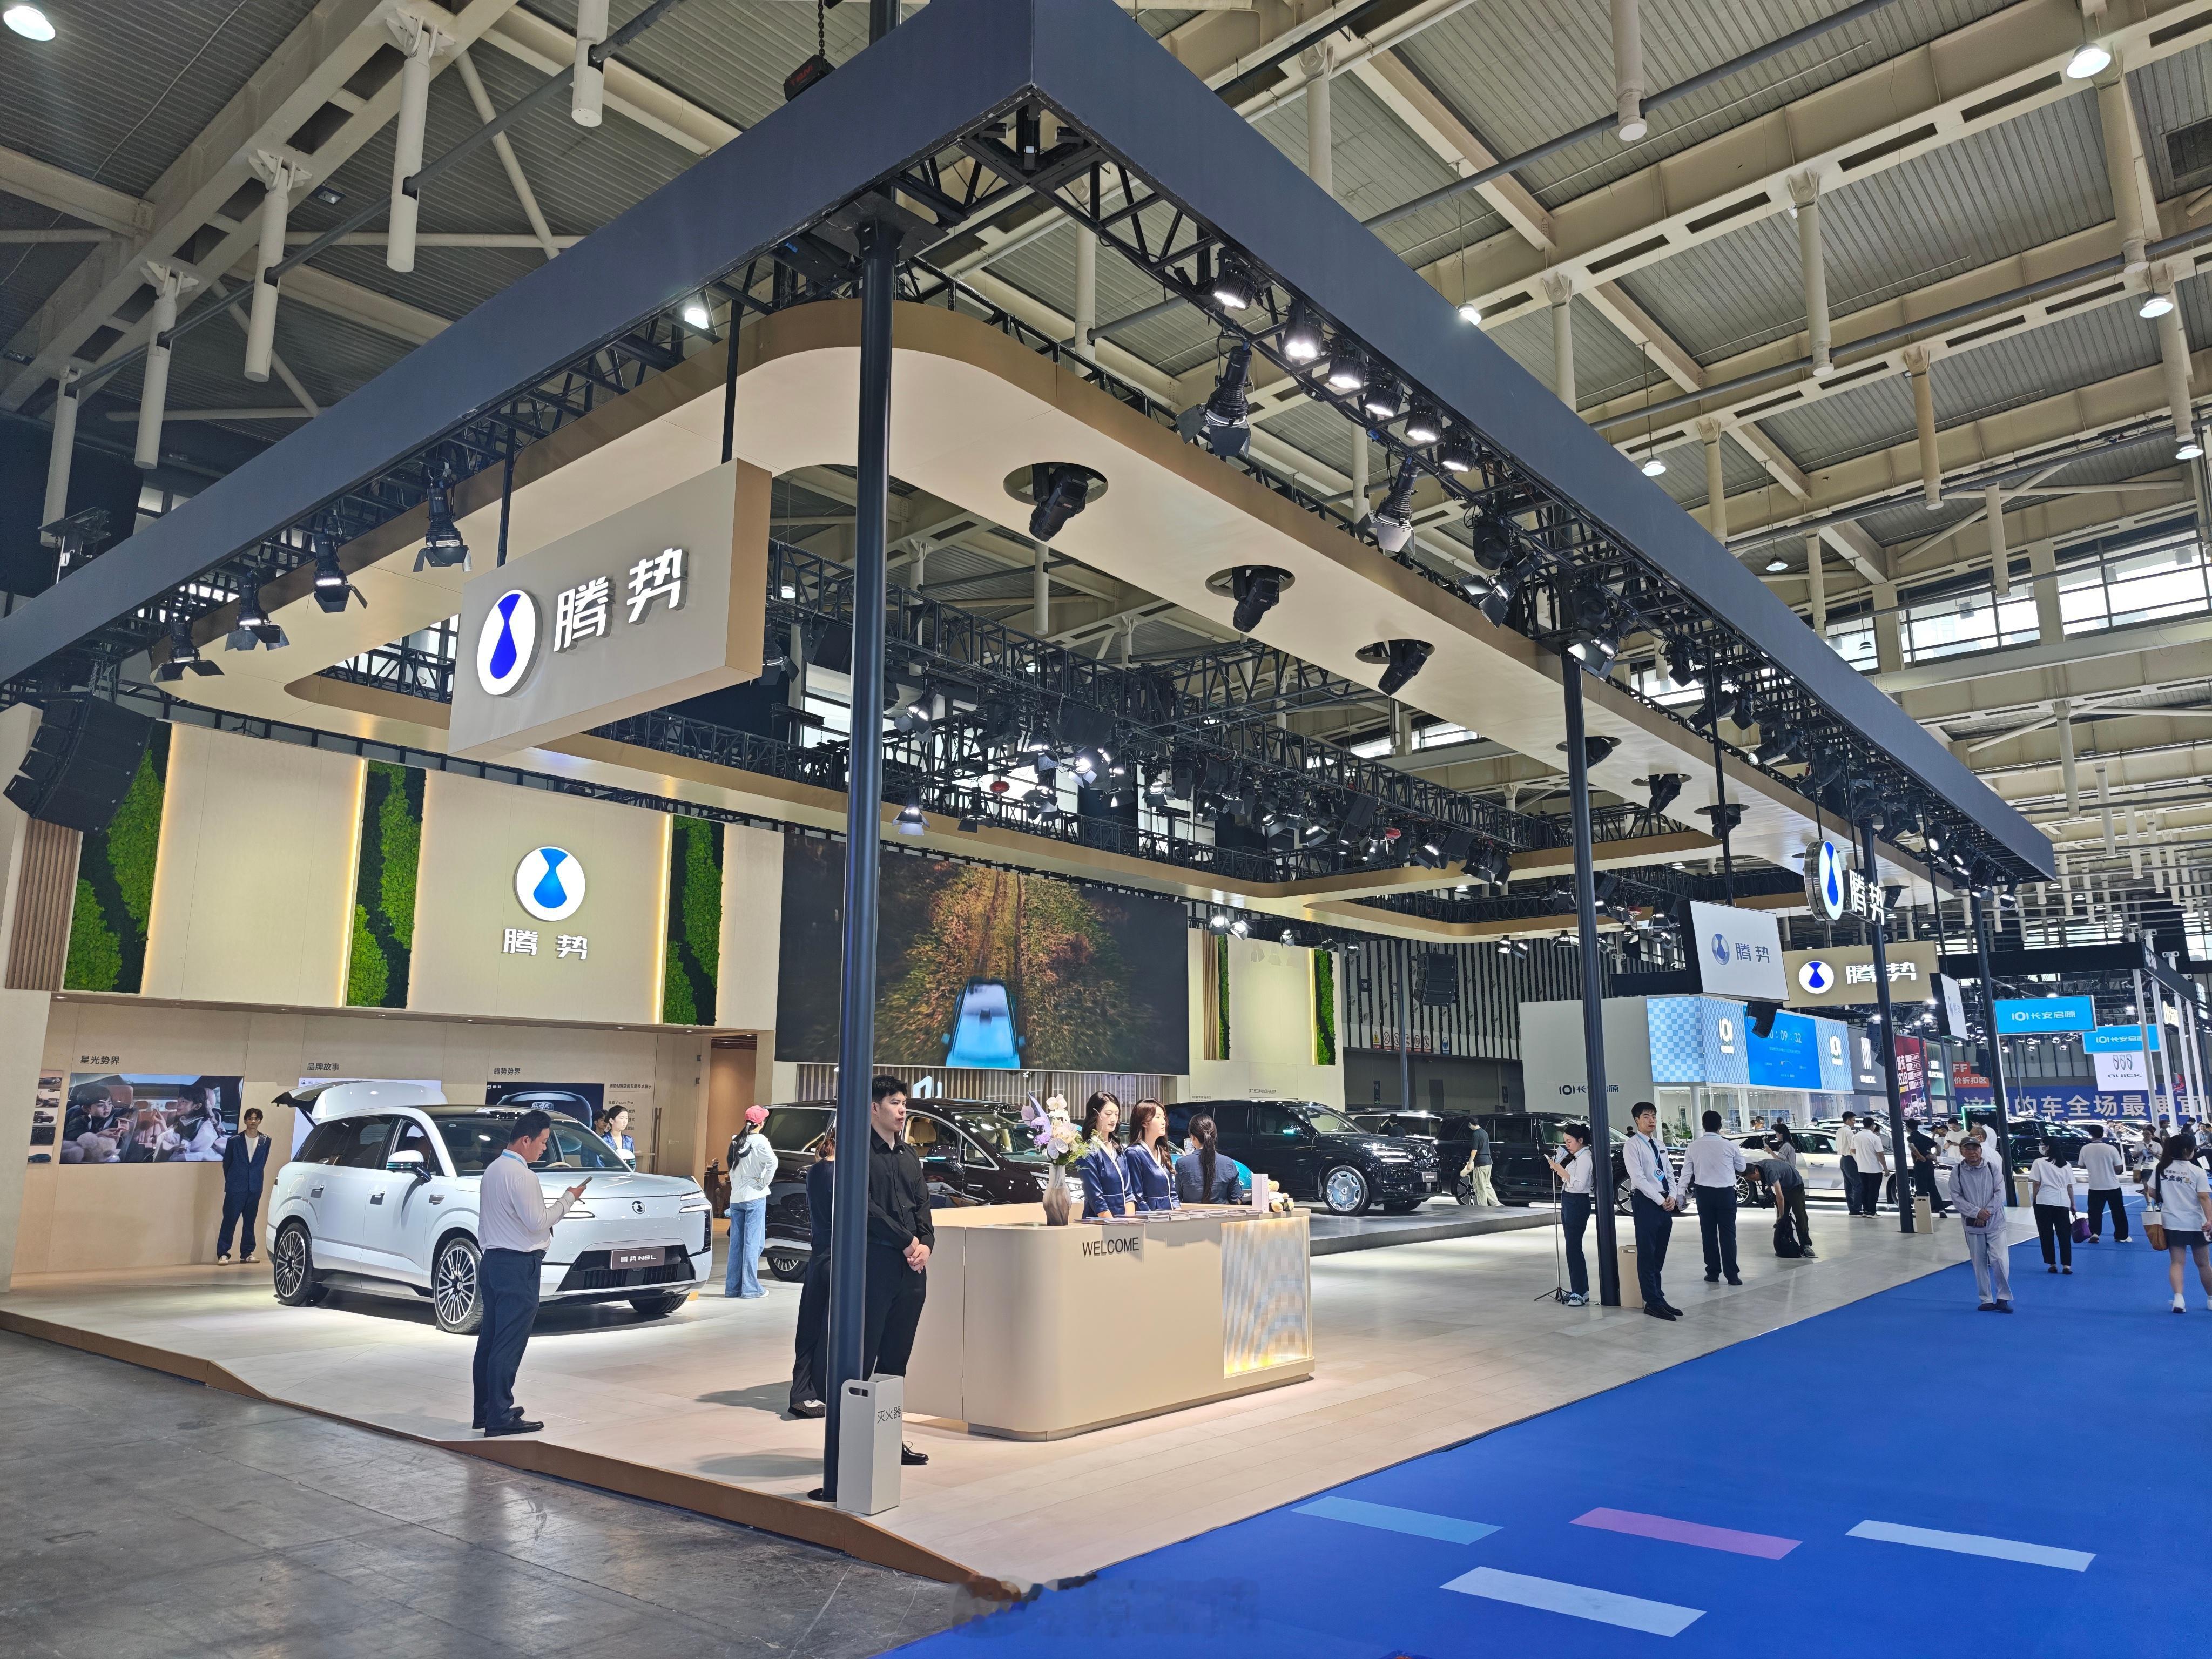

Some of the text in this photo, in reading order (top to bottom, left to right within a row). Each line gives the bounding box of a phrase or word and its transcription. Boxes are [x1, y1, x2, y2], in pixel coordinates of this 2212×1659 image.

[554, 547, 687, 652] 腾势
[1849, 869, 1885, 926] 腾势
[502, 928, 588, 960] 腾势
[1735, 942, 1770, 963] 腾势
[1845, 962, 1917, 984] 腾势
[80, 1055, 120, 1065] 星光势界
[307, 1062, 340, 1071] 品牌故事
[1953, 1064, 1967, 1073] FF
[494, 1067, 521, 1075] 腾势势界
[1954, 1076, 1987, 1084] 价折扣区
[1082, 1237, 1139, 1257] WELCOME
[877, 1406, 901, 1424] 灭火器
